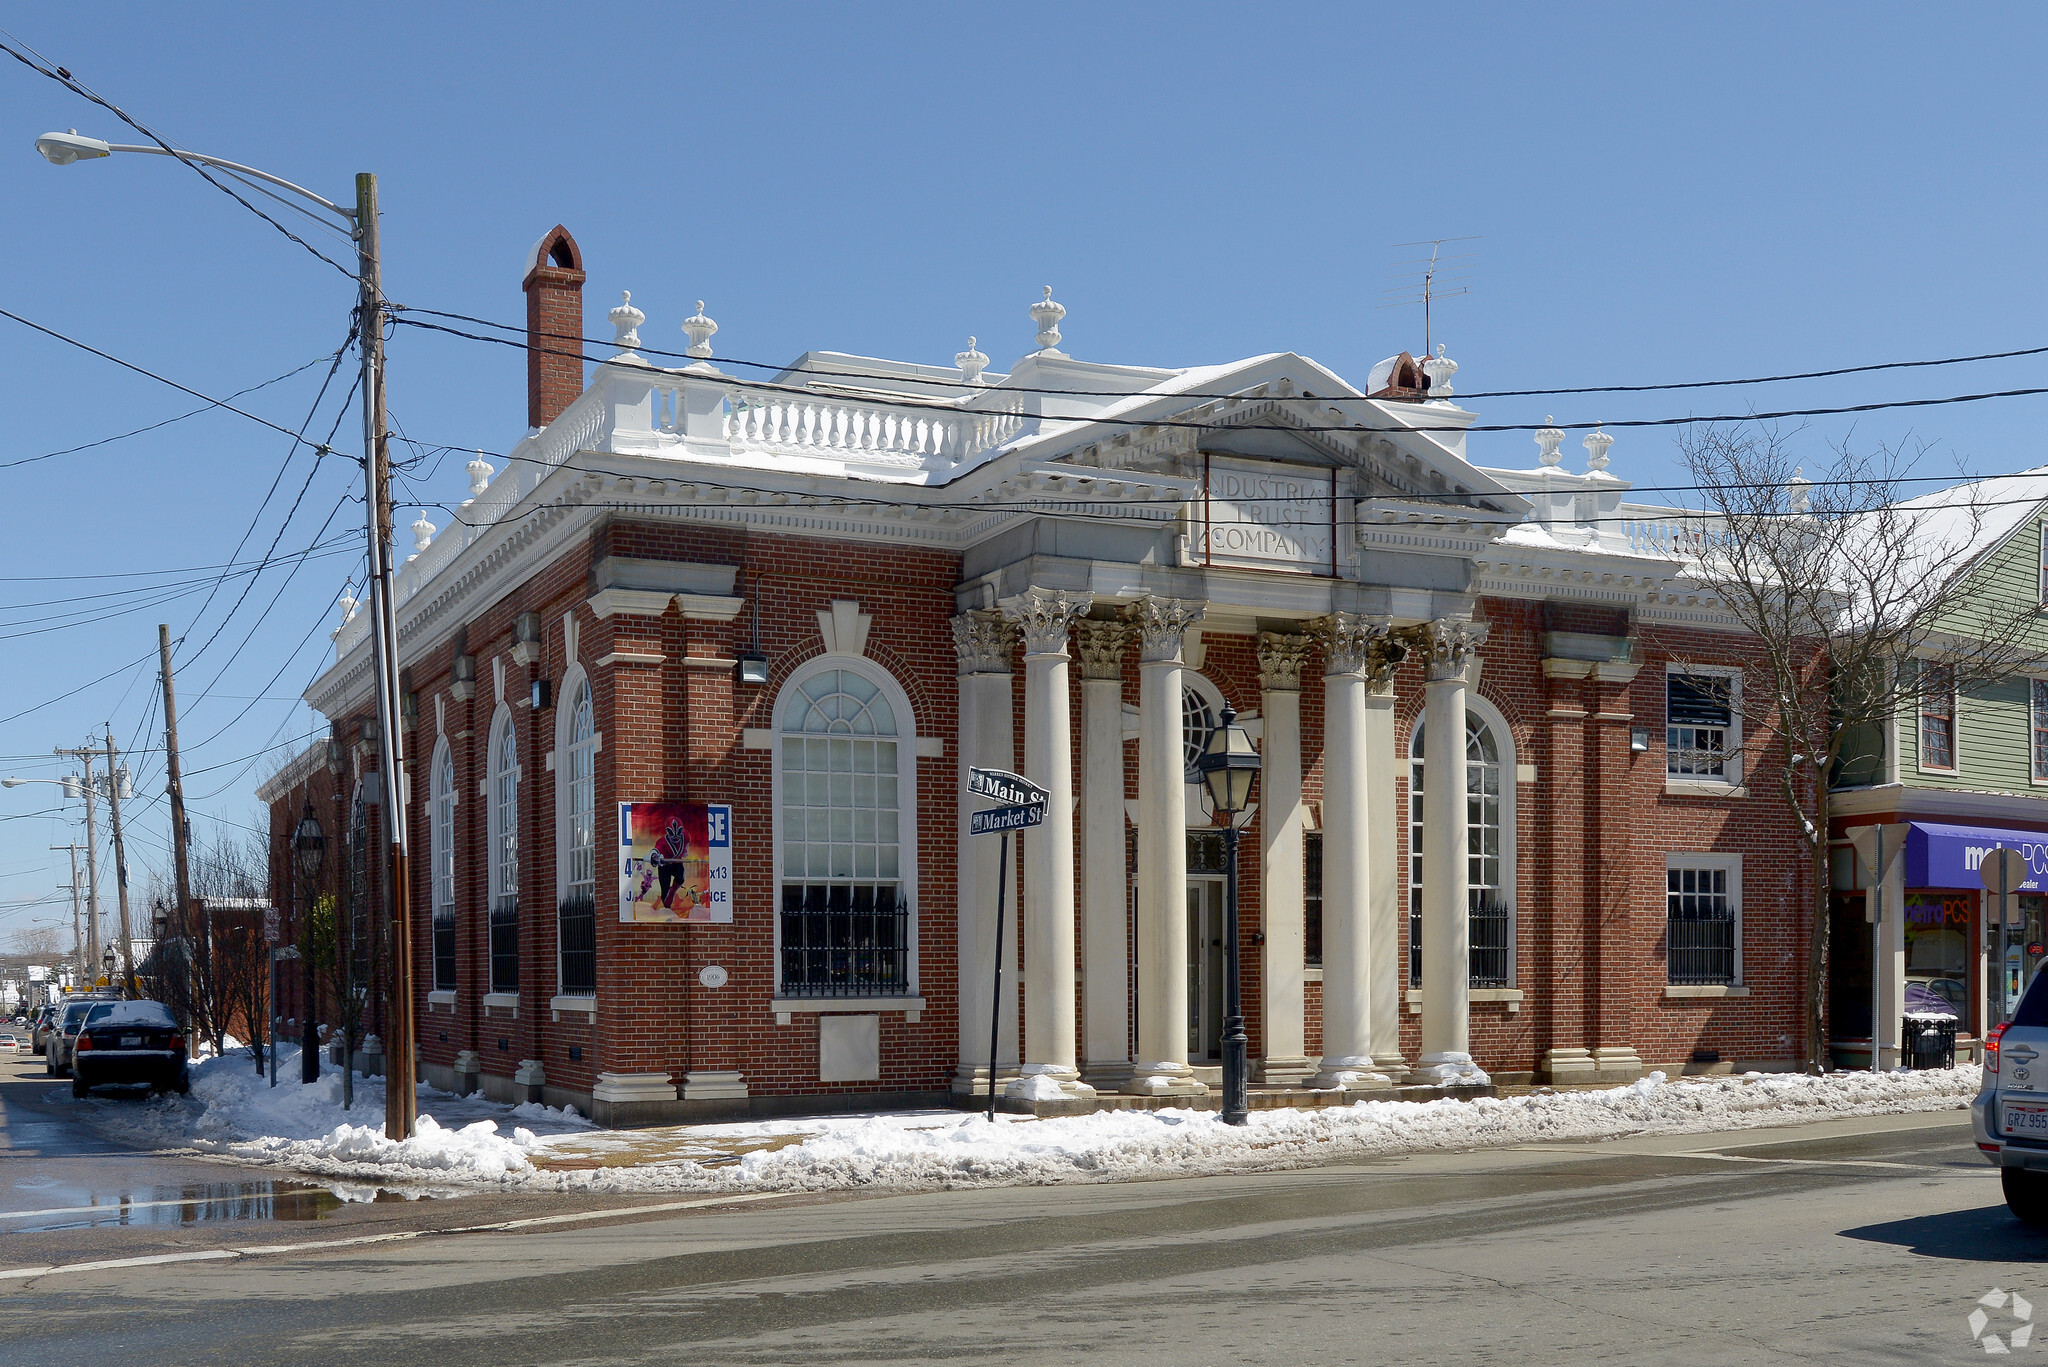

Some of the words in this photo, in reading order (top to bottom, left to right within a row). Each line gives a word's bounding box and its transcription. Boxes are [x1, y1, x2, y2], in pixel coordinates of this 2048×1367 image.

[1209, 473, 1332, 507] NDUSTRIAL
[1232, 502, 1309, 531] TRUST
[1211, 527, 1326, 558] COMPANY
[984, 777, 1024, 803] Main
[983, 810, 1025, 830] Market
[1028, 806, 1041, 823] St
[2007, 1112, 2027, 1127] GRZ
